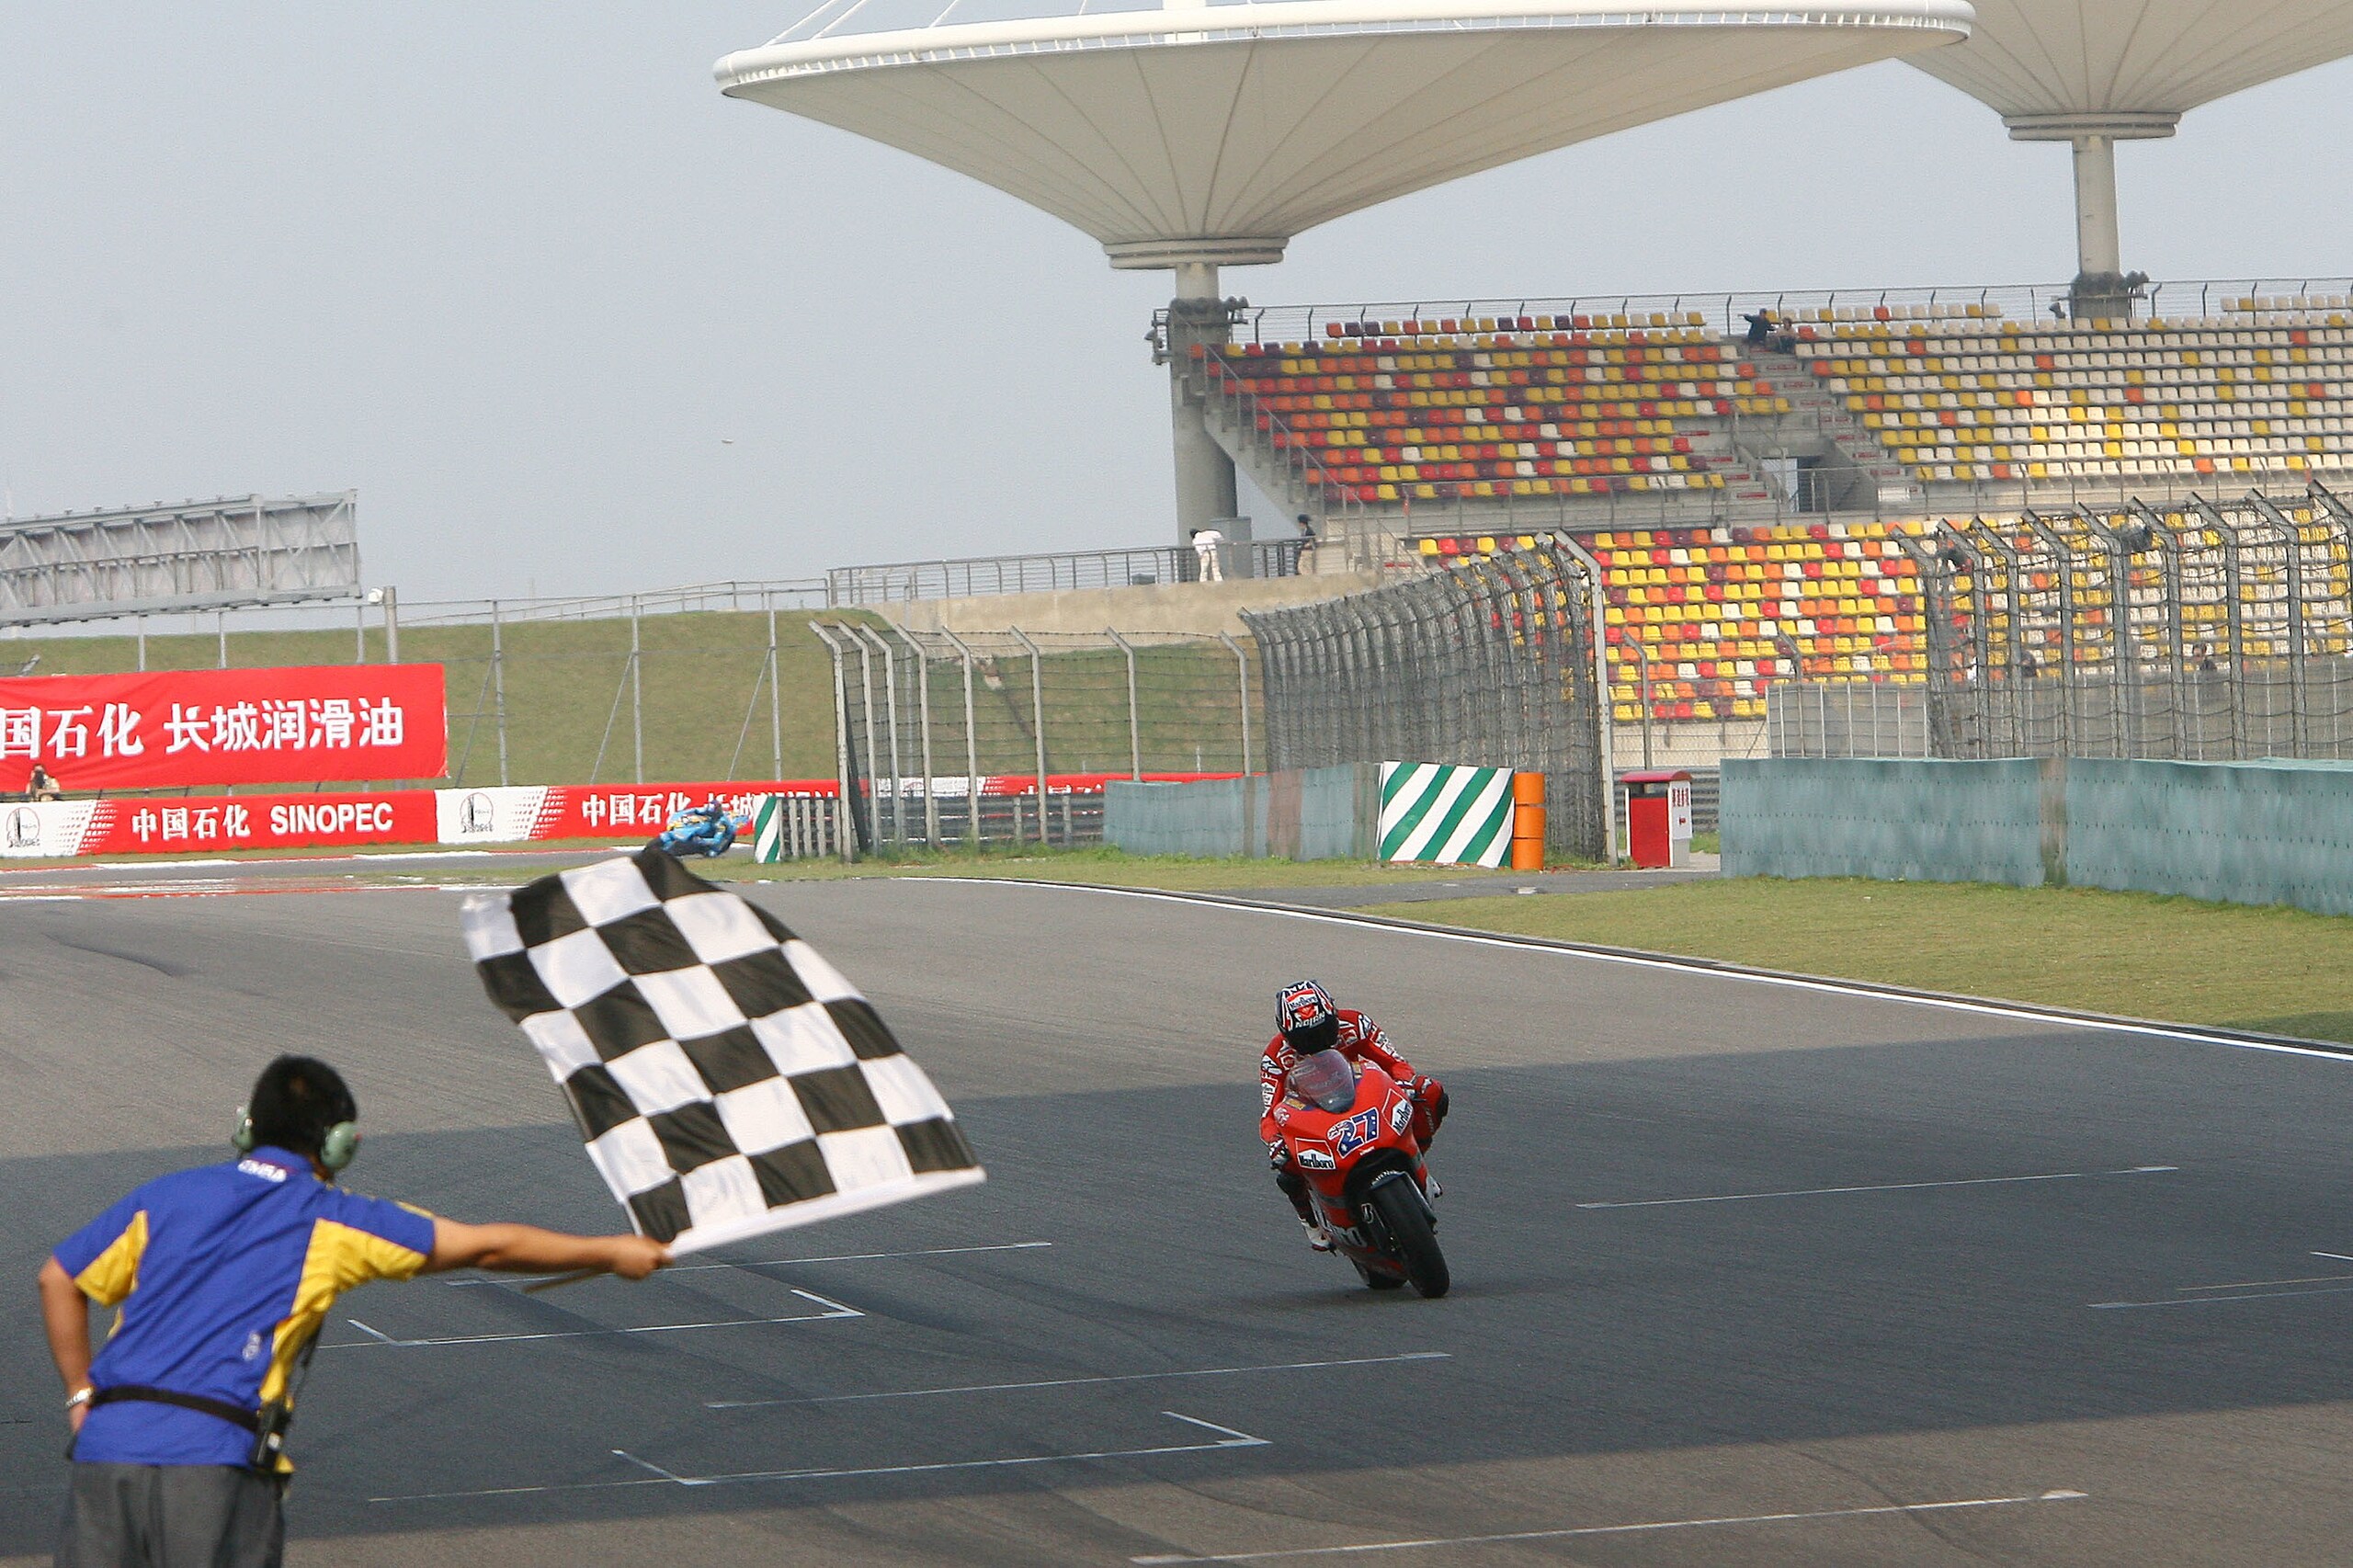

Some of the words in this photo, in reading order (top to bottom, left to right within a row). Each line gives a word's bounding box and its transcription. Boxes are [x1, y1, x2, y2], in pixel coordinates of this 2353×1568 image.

[0, 703, 144, 759] 国石化
[163, 697, 404, 755] 长城润滑油
[131, 802, 251, 843] 中国石化
[270, 802, 394, 835] SINOPEC
[1326, 1107, 1380, 1160] 27
